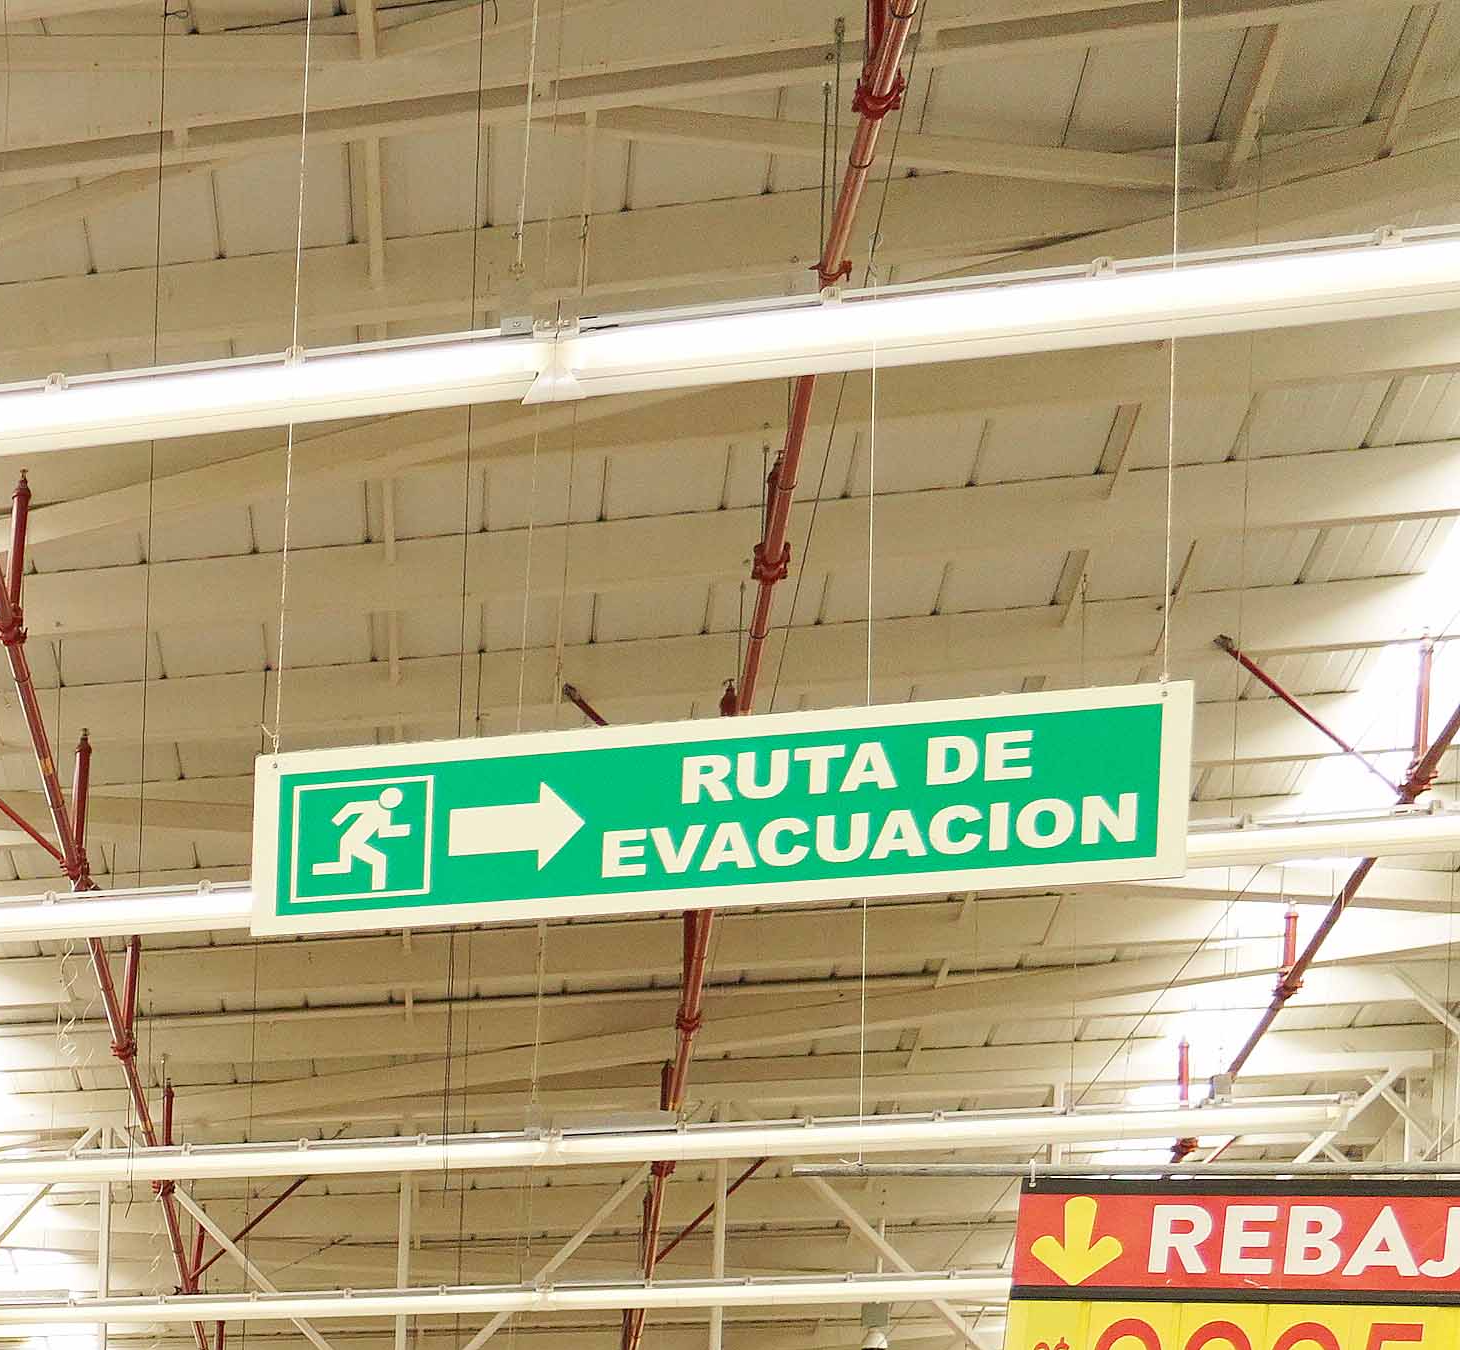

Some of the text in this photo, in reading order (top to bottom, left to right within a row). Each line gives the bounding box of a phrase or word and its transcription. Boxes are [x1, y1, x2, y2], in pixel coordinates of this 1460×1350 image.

[680, 730, 1033, 805] RUTA DE
[600, 793, 1138, 879] EVACUACION
[1147, 1203, 1460, 1277] REBAJ
